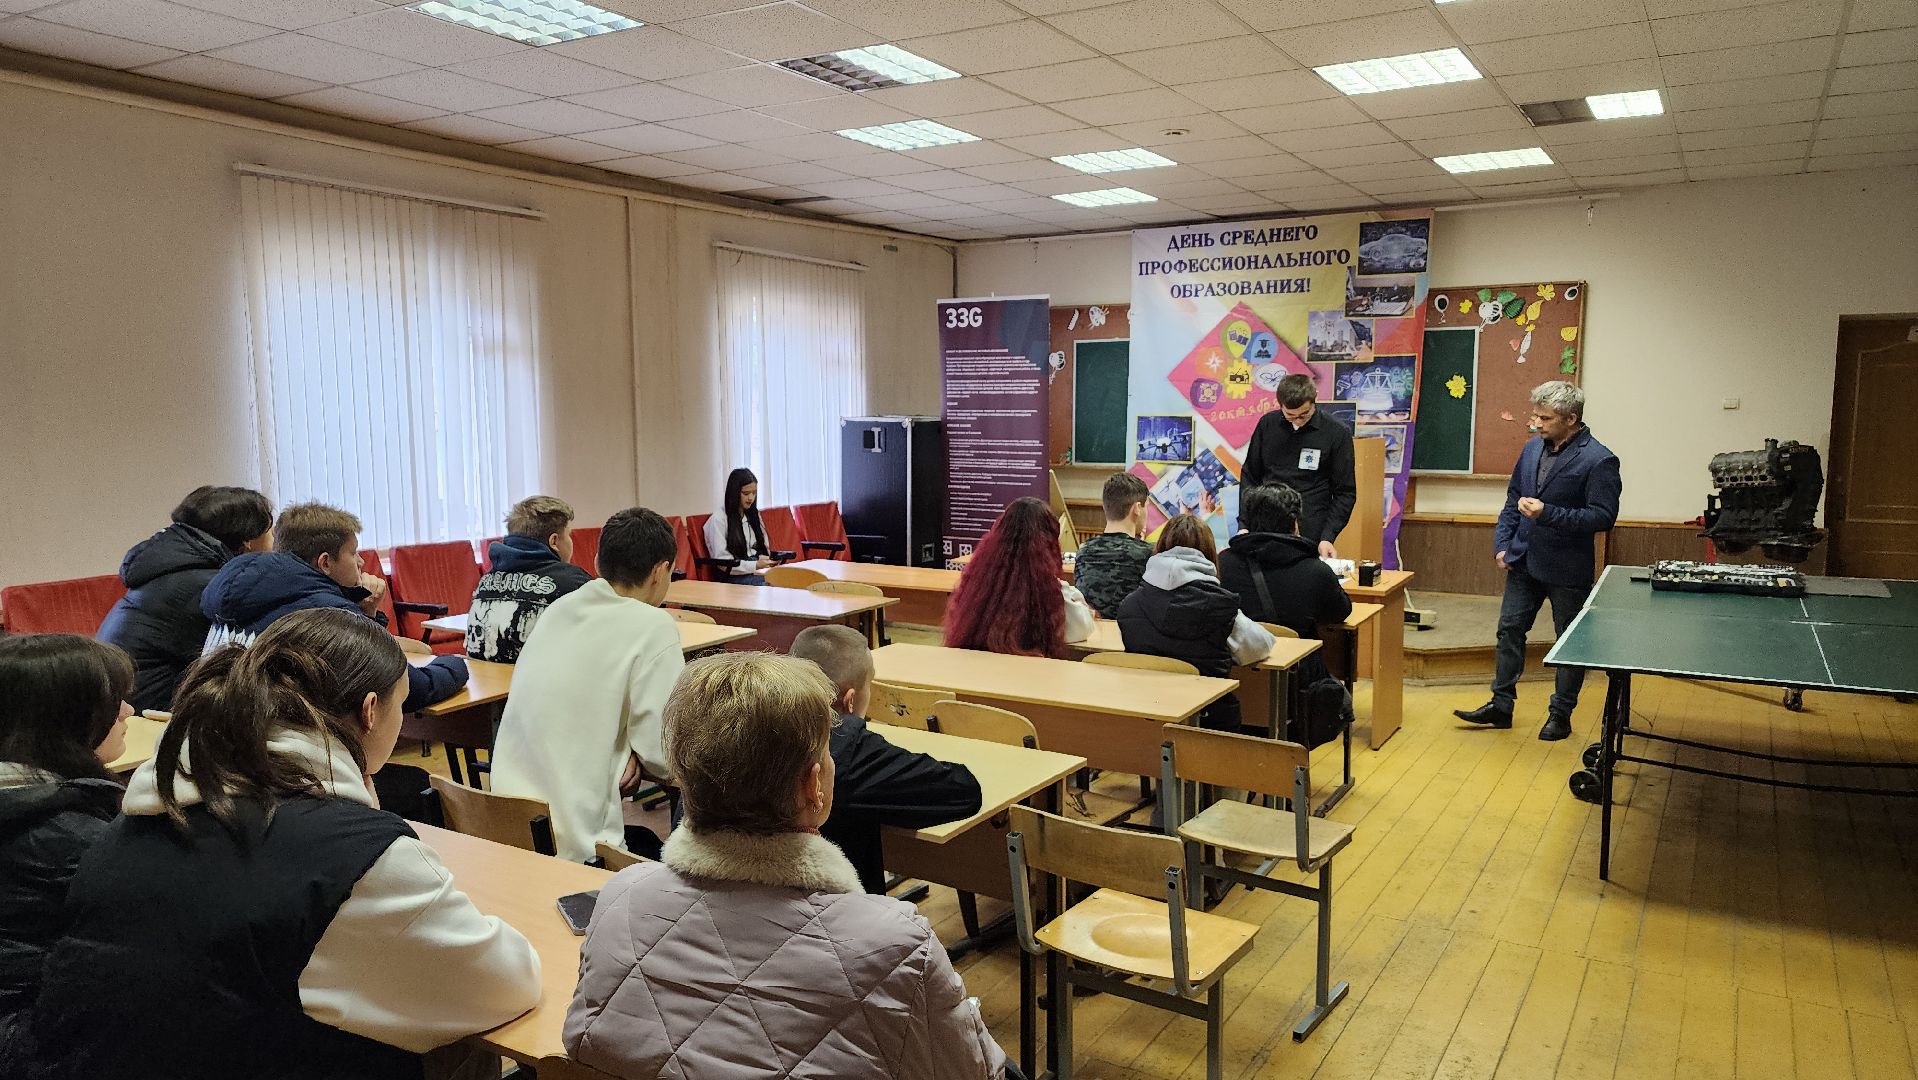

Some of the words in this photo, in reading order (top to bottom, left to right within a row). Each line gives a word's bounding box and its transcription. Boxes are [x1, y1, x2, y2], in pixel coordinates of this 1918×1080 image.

[1167, 232, 1214, 252] ДЕНЬ
[1219, 225, 1318, 246] СРЕДНЕГО
[1138, 248, 1351, 276] ПРОФЕССИОНАЛЬНОГО
[1170, 277, 1311, 299] ОБРАЗОВАНИЯ!
